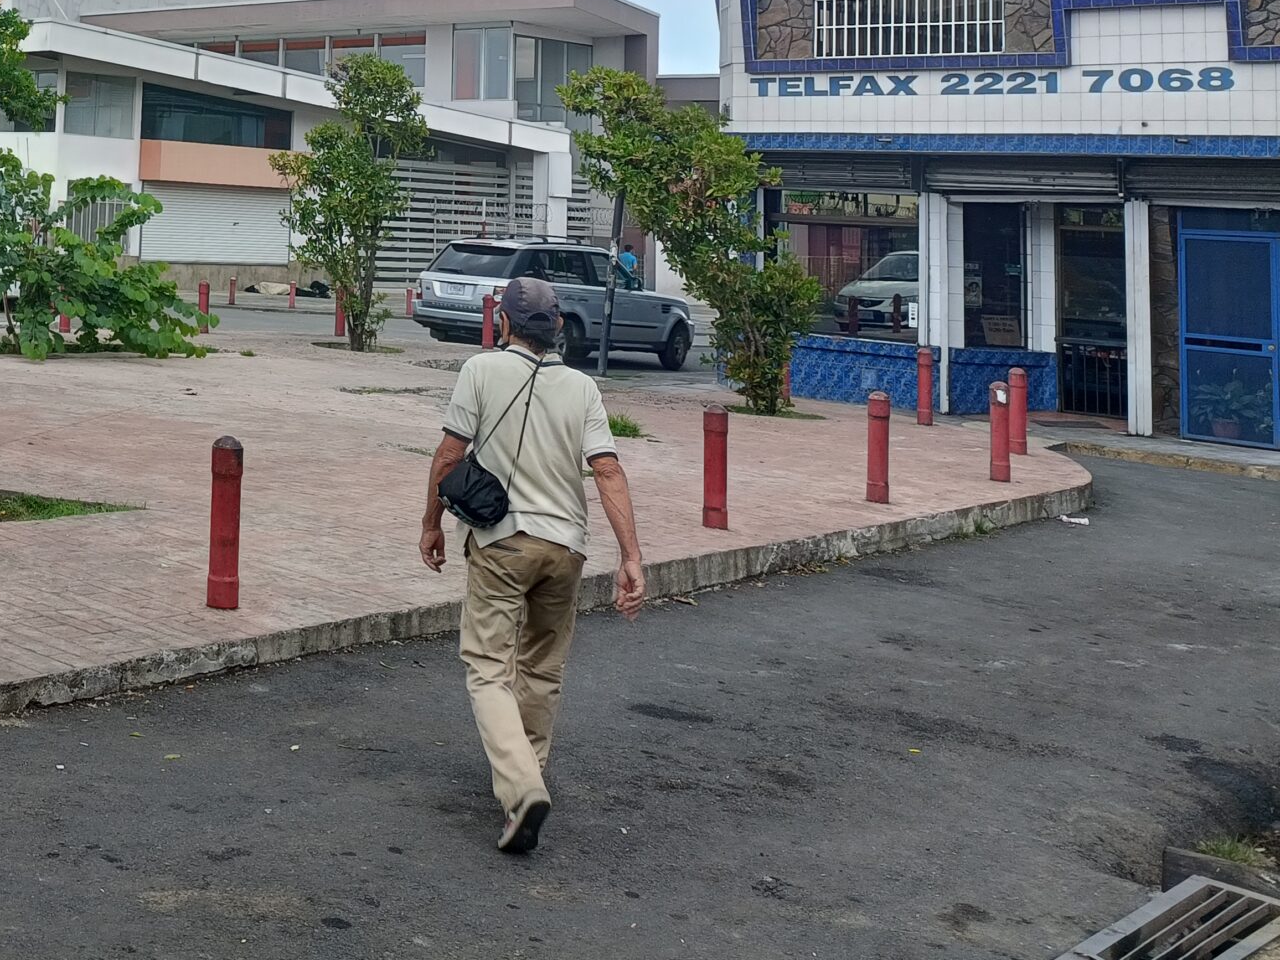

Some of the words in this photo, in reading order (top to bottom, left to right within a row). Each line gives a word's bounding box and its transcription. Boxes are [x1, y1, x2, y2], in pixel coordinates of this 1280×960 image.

[750, 75, 919, 97] TELFAX
[940, 71, 1059, 95] 2221
[1082, 66, 1235, 93] 7068
